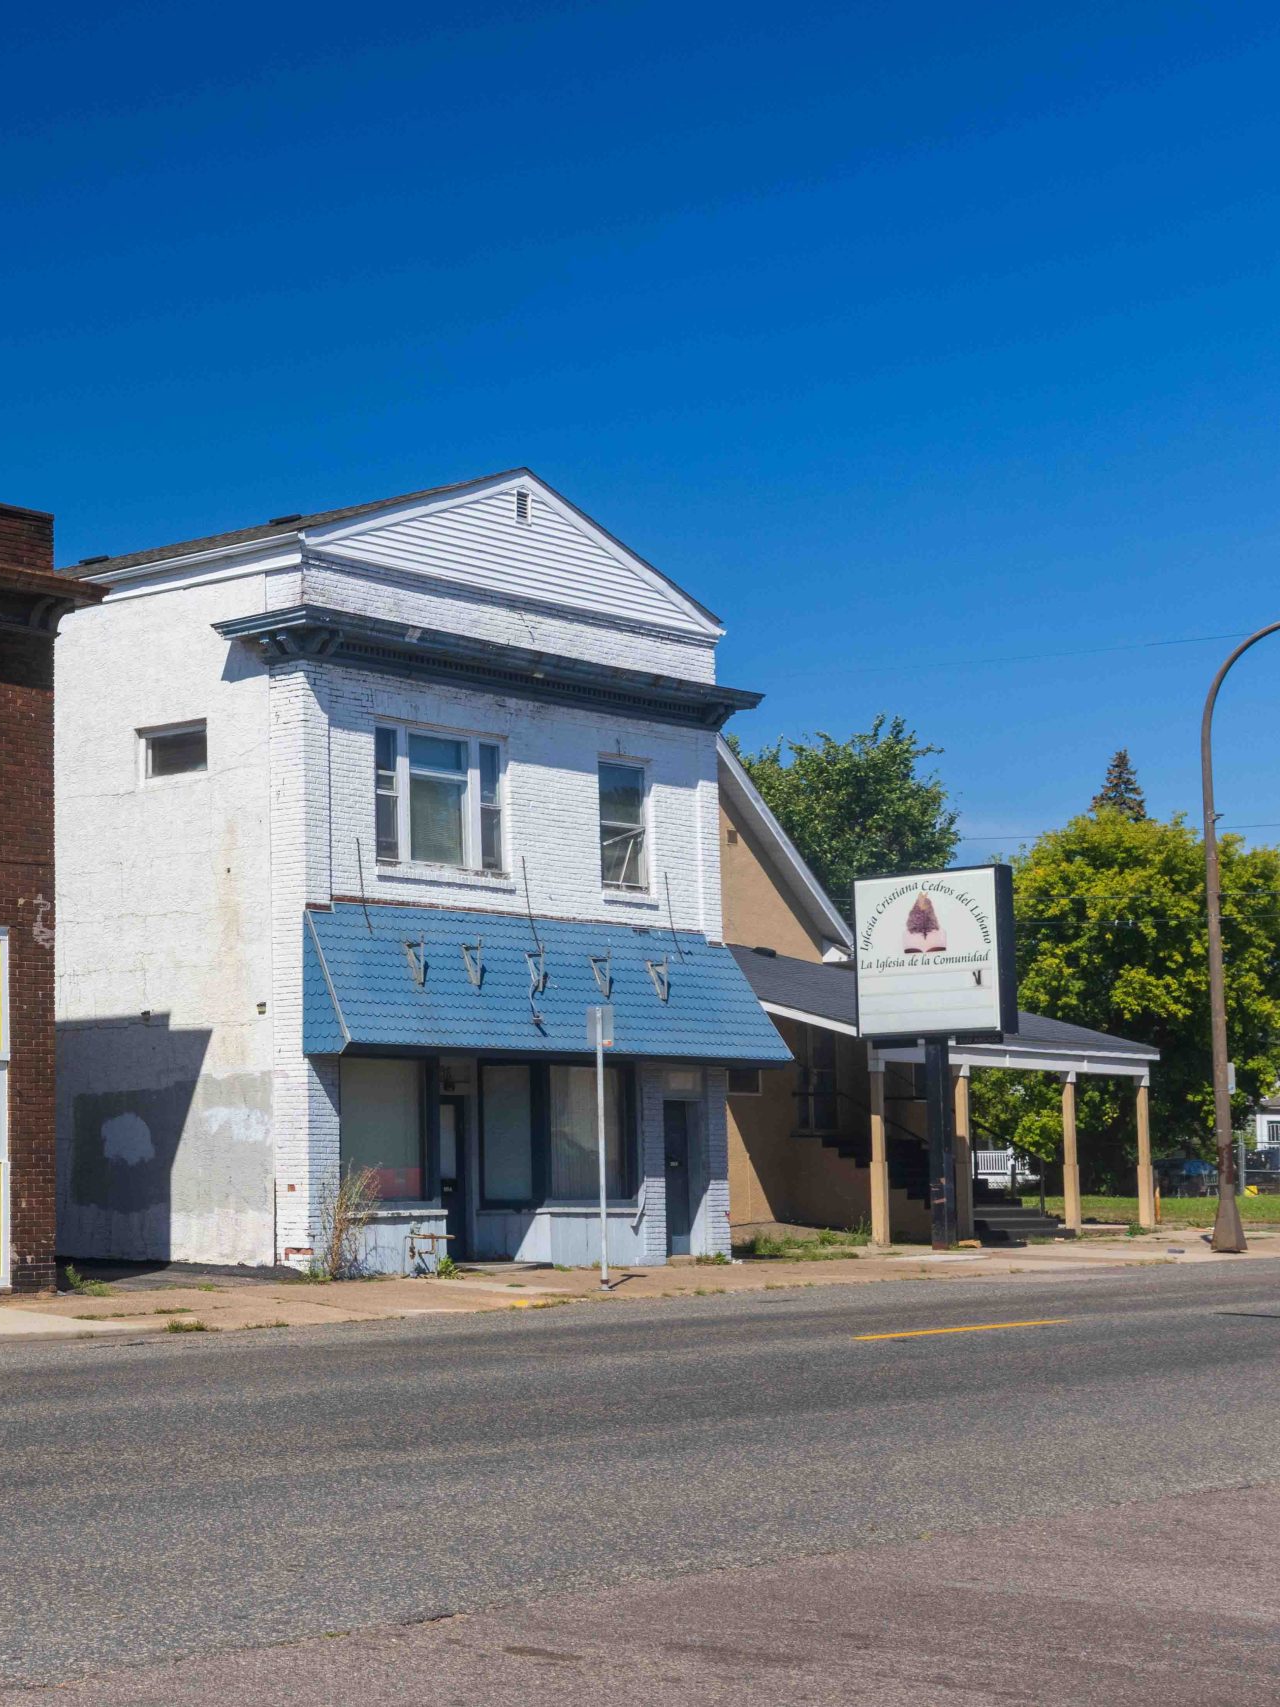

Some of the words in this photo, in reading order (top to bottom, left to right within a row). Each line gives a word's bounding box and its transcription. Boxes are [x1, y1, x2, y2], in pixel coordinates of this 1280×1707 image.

[860, 917, 878, 951] Iglesia
[876, 881, 918, 915] Cristiana
[921, 879, 954, 896] Cedros
[956, 892, 971, 907] del
[860, 960, 873, 970] La
[876, 956, 905, 973] Iglesia
[908, 956, 919, 967] de
[921, 954, 930, 966] la
[933, 949, 991, 965] Comunidad
